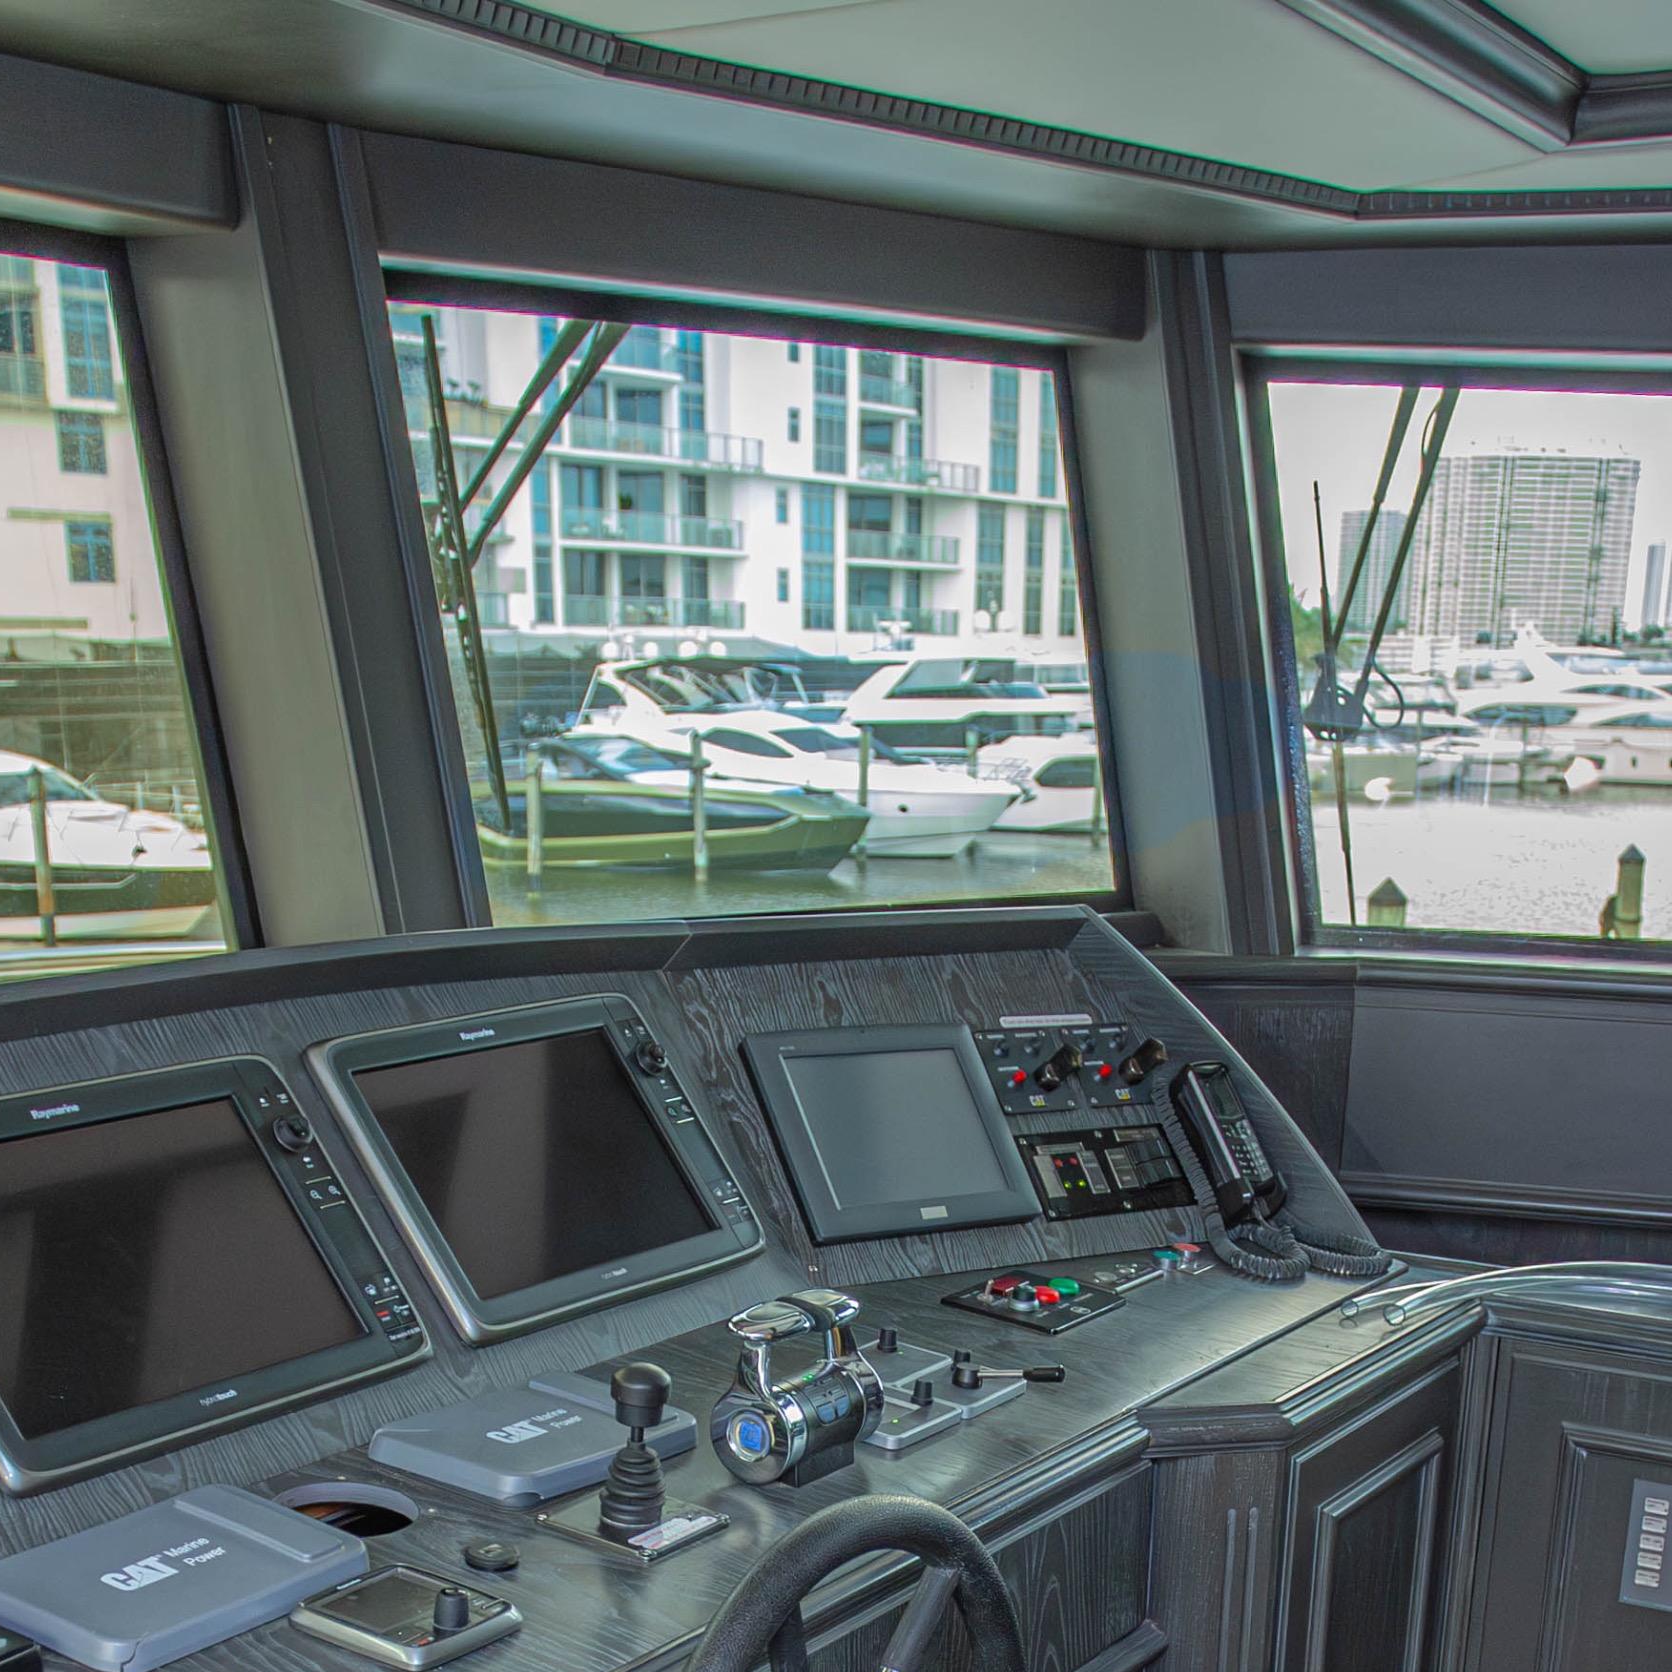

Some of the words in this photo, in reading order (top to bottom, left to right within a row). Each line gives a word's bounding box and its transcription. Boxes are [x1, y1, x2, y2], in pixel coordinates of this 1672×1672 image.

[30, 1104, 80, 1120] Raymarine
[486, 1419, 548, 1444] CAT
[530, 1408, 567, 1422] Marine
[100, 1553, 179, 1591] CAT
[162, 1536, 210, 1559] Marine
[183, 1545, 227, 1567] Power
